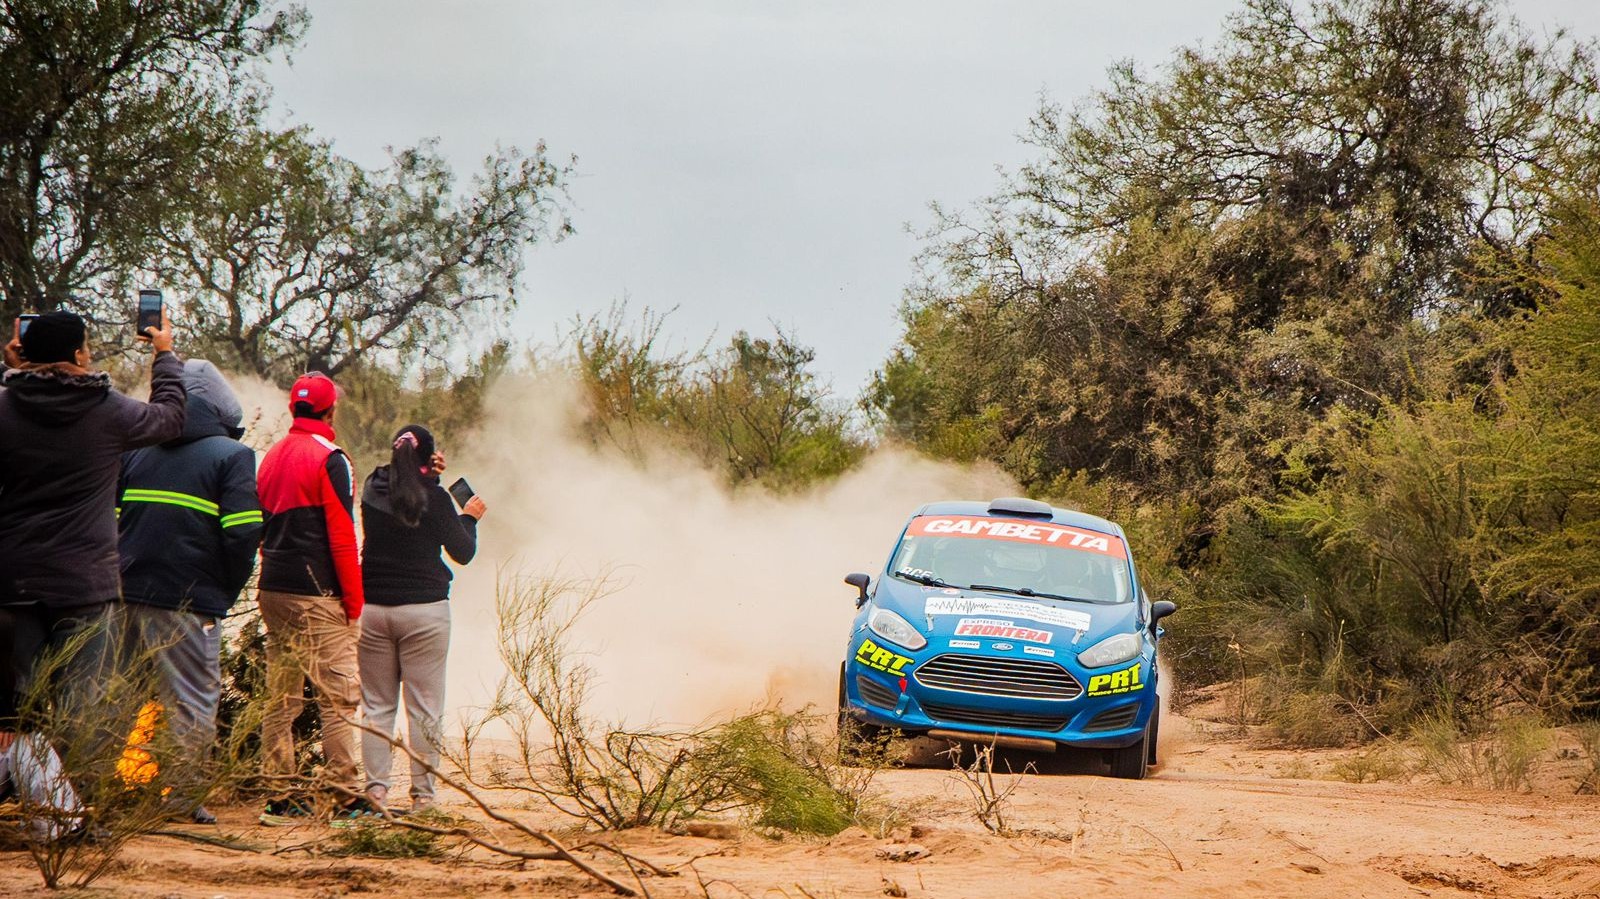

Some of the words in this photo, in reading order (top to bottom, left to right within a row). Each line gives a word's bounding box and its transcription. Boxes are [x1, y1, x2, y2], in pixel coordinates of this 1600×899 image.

[923, 519, 1109, 552] GAMBETTA
[957, 625, 1049, 642] FRONTERA
[857, 638, 915, 671] PRT
[1088, 662, 1141, 692] PRT
